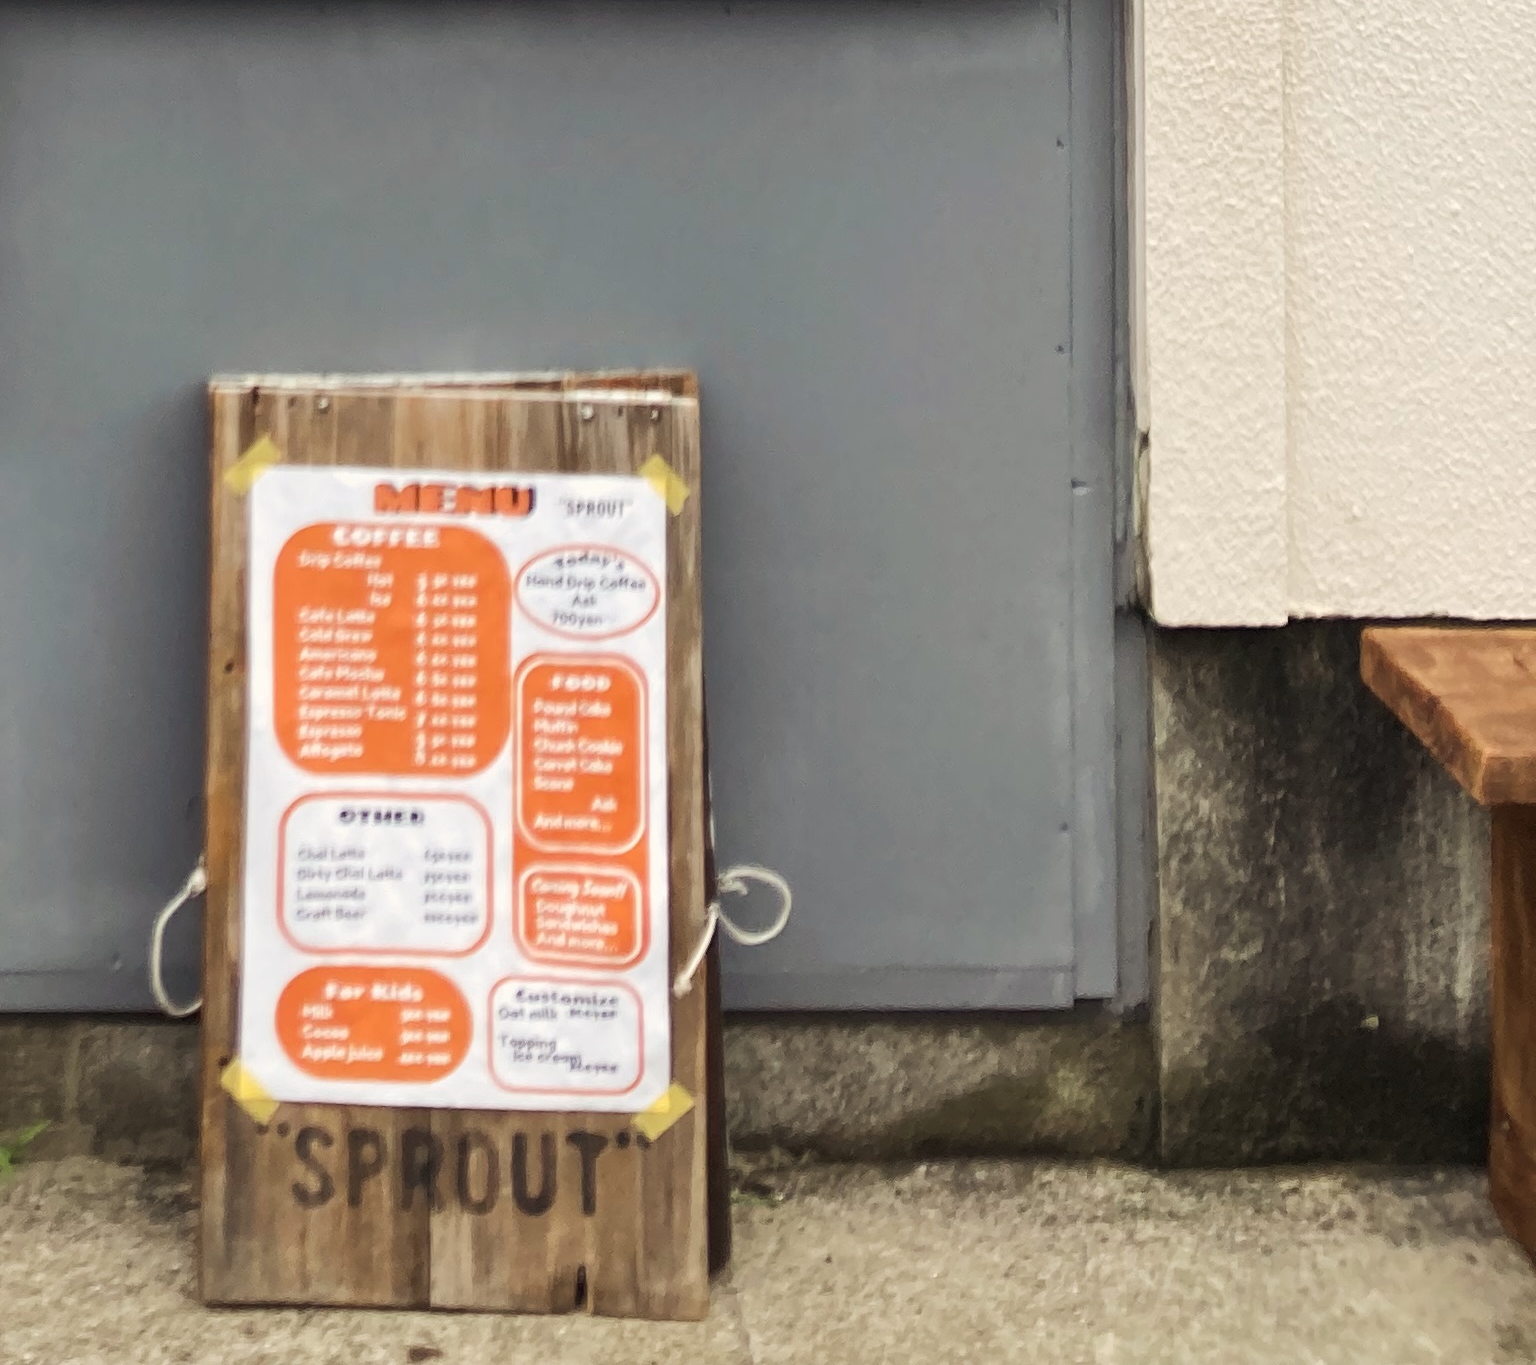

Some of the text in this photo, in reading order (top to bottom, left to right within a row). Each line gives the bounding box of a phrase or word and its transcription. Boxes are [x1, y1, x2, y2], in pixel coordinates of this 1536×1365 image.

[374, 482, 536, 517] MENU
[332, 524, 440, 548] COFFEE
[526, 575, 563, 588] Hand
[599, 576, 646, 591] Coffee
[299, 646, 378, 663] Americano
[550, 673, 611, 692] FOOD
[338, 806, 425, 825] OTHER
[324, 980, 424, 1002] For Kids
[516, 988, 618, 1005] Customize
[501, 1034, 556, 1054] Topping
